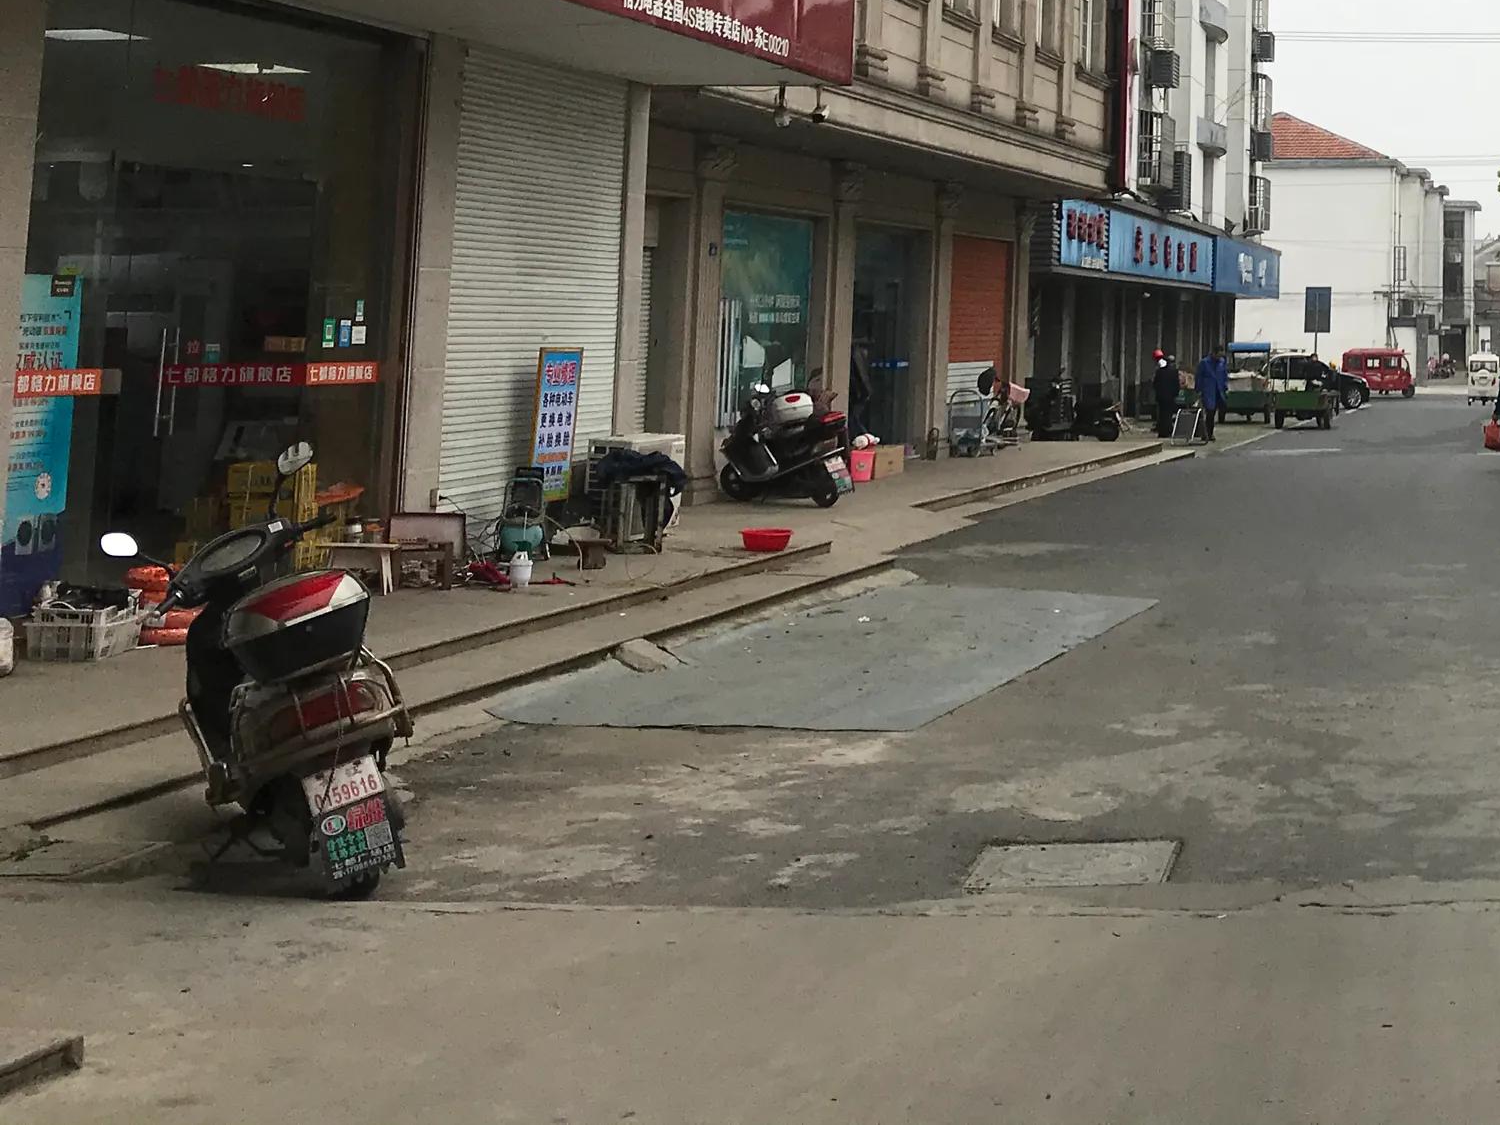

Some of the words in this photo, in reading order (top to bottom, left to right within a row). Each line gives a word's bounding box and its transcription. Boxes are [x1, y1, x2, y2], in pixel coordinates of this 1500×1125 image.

[165, 366, 292, 384] 七都格力旗舰店
[309, 365, 373, 383] 七都格力旗舰店
[542, 391, 574, 409] 各种电动车
[539, 412, 572, 429] 更换电池
